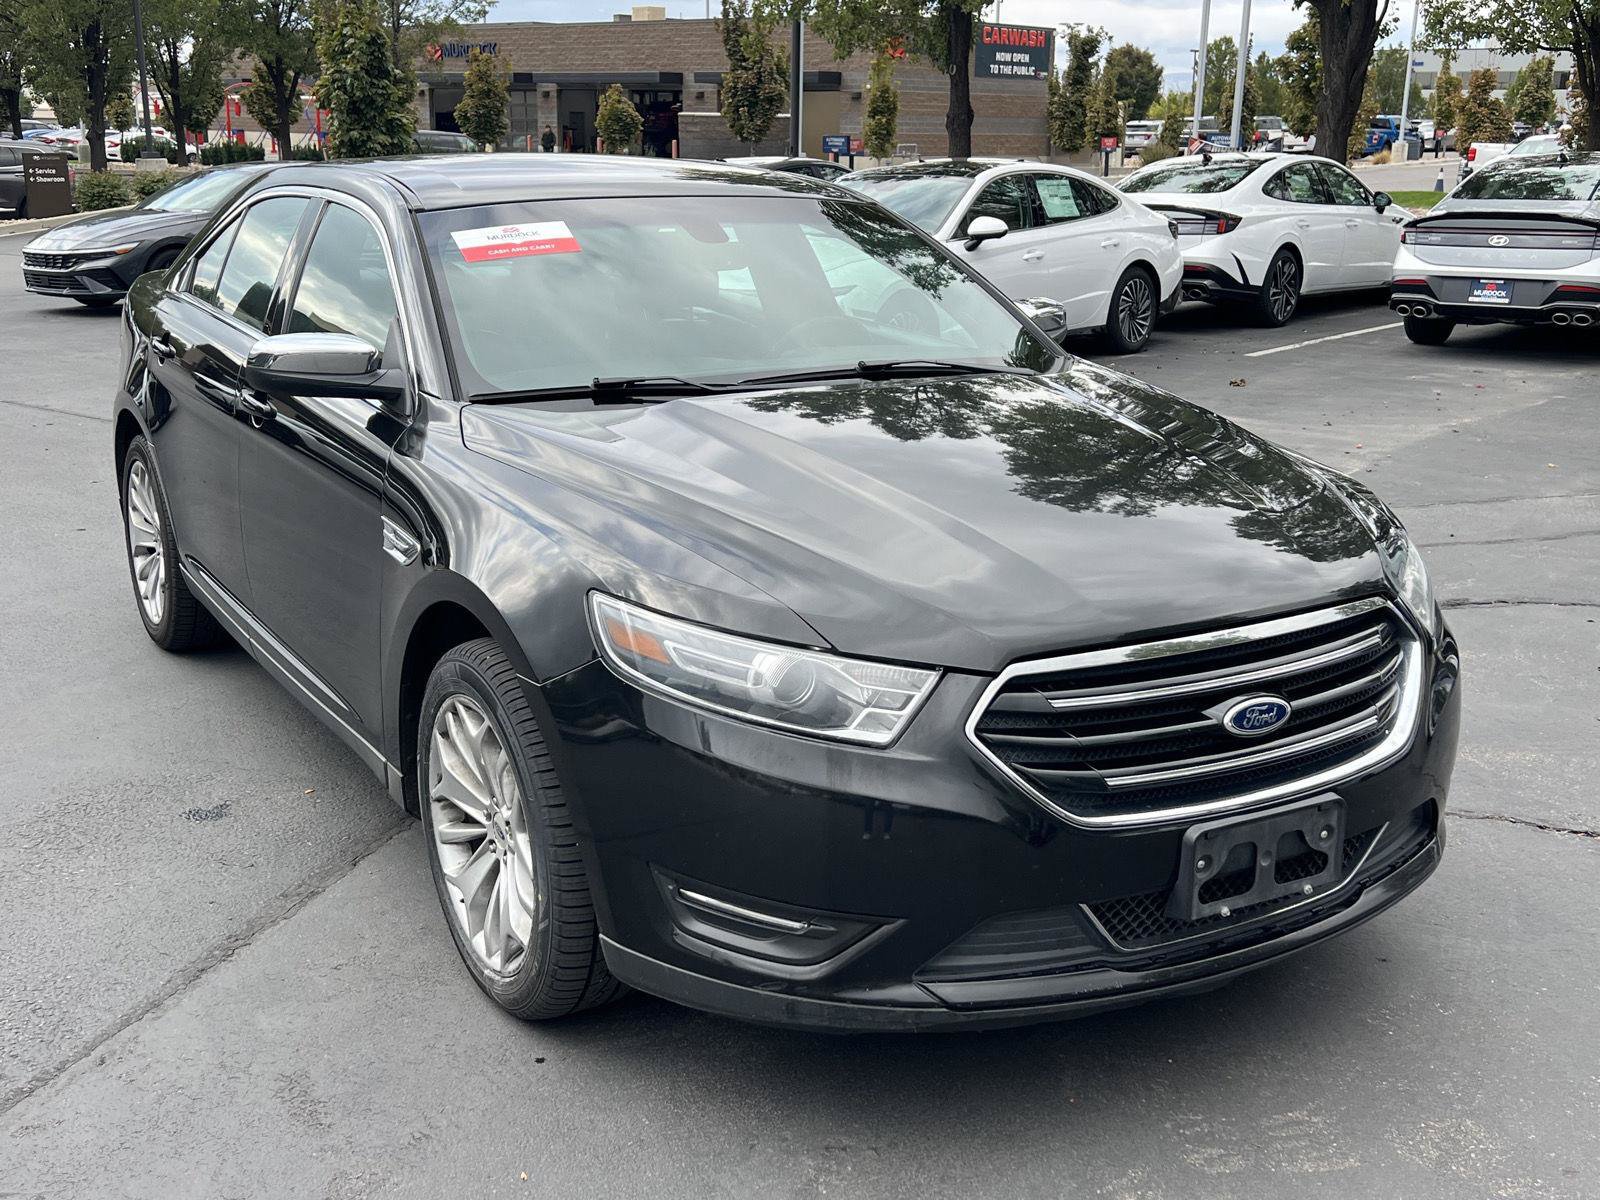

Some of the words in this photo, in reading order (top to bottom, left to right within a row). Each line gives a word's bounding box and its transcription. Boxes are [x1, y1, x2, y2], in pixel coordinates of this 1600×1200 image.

[982, 25, 1046, 48] CARWASH
[443, 42, 497, 58] MURDCK
[995, 51, 1012, 63] NOW
[1013, 53, 1030, 63] OPEN
[990, 64, 999, 74] TO
[1000, 65, 1012, 75] THE
[1013, 66, 1036, 76] PUBLIC
[487, 230, 540, 241] MURDOCK
[487, 248, 510, 256] CASH
[1473, 289, 1507, 297] MURDOCK
[1243, 704, 1277, 728] Ford
